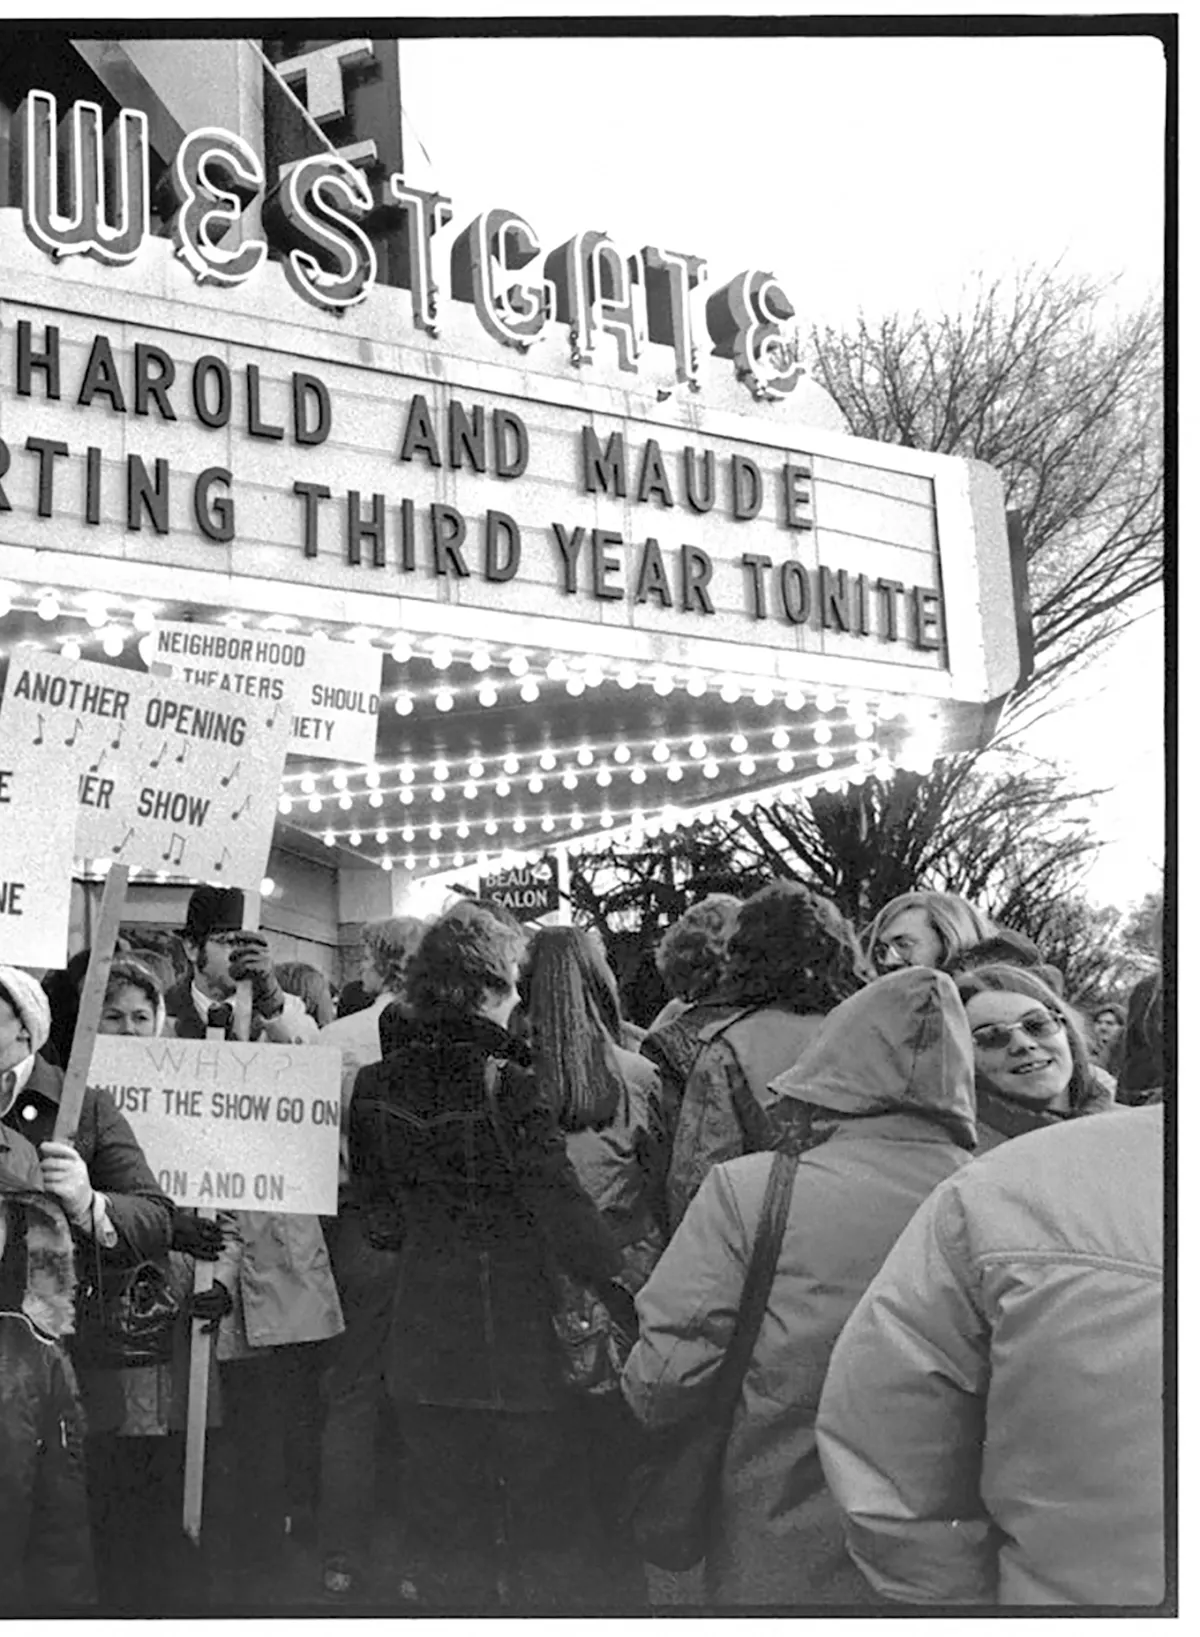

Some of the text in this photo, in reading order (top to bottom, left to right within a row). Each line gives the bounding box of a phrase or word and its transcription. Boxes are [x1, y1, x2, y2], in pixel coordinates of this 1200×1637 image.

[18, 88, 806, 401] WESTGATE
[16, 320, 813, 531] HAROLD AND MAUDE
[293, 482, 519, 583] THIRD
[552, 524, 714, 614] YEAR
[742, 554, 941, 651] TONITE
[159, 631, 307, 666] NEIGHBORHOOD
[14, 671, 246, 746] ANOTHER OPENING
[312, 685, 380, 715] SHOULD
[290, 716, 335, 741] IETY
[138, 788, 210, 826] SHOW
[491, 889, 548, 907] SALON
[163, 1090, 202, 1116] THE
[212, 1093, 270, 1121] SHOW
[277, 1097, 304, 1123] GO
[312, 1100, 338, 1127] ON
[200, 1172, 244, 1198] AND
